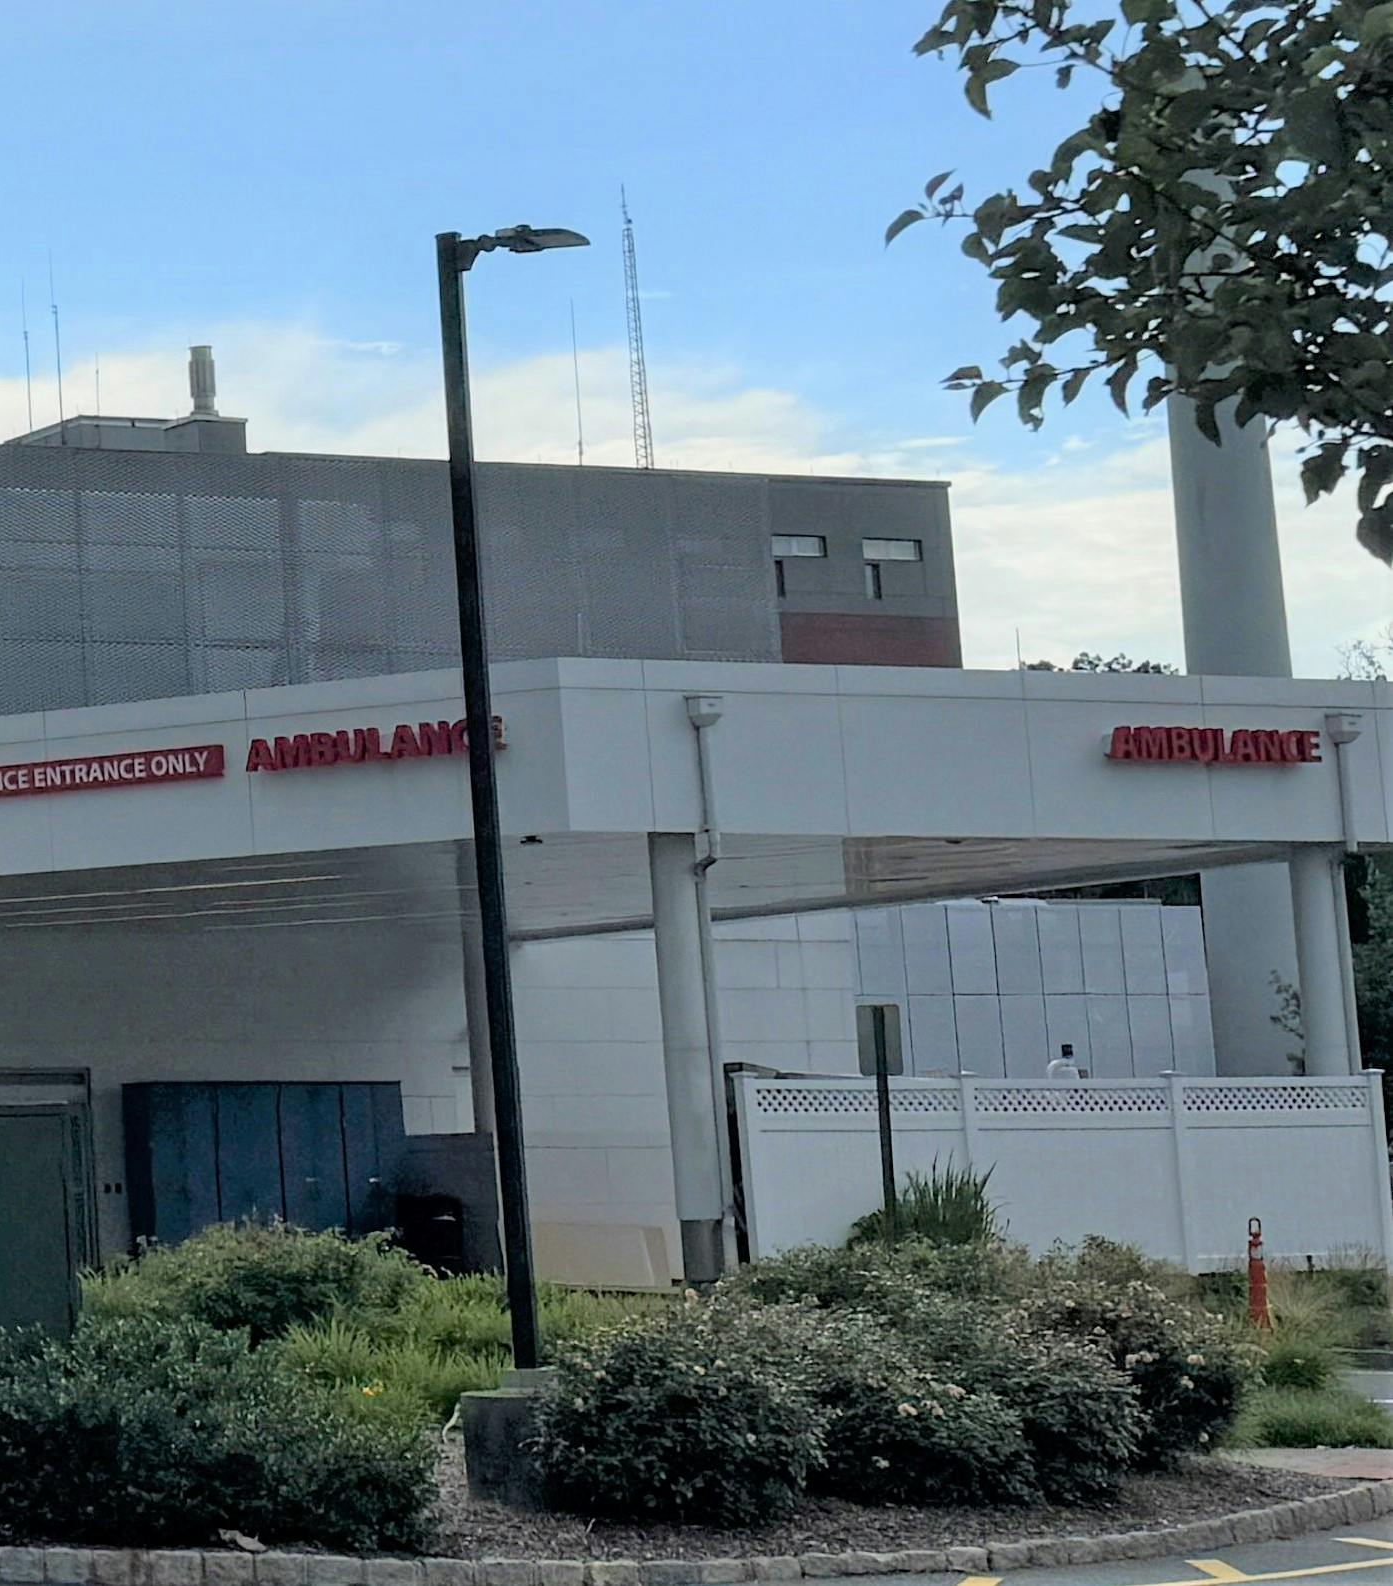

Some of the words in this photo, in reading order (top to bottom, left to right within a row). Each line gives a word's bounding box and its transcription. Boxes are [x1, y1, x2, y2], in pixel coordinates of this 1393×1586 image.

[1109, 725, 1322, 766] AMBULANCE
[34, 757, 147, 788] ENTRANCE
[150, 751, 209, 777] ONLY
